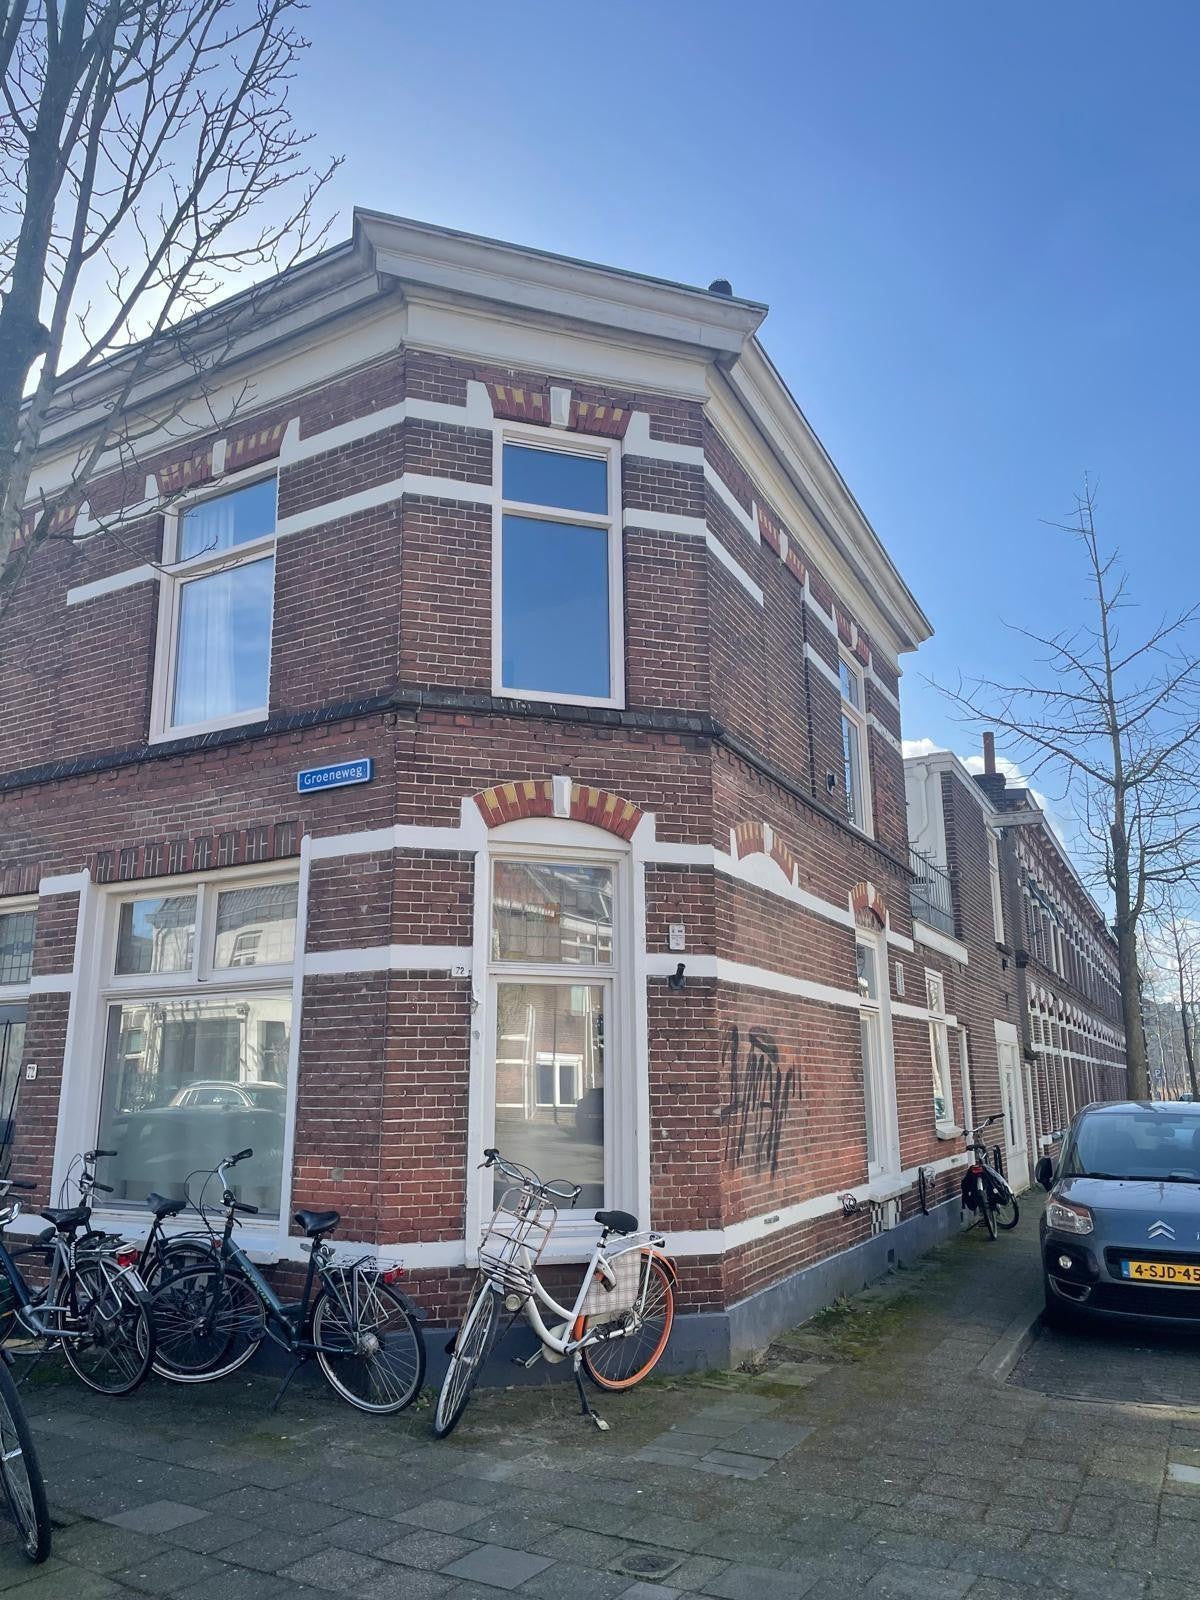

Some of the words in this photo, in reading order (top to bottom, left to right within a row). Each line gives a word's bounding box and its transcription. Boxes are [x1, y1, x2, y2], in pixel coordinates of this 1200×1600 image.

[304, 766, 363, 785] Groeneweg
[456, 966, 465, 975] 72
[1135, 1264, 1200, 1281] 4-SJD-45
